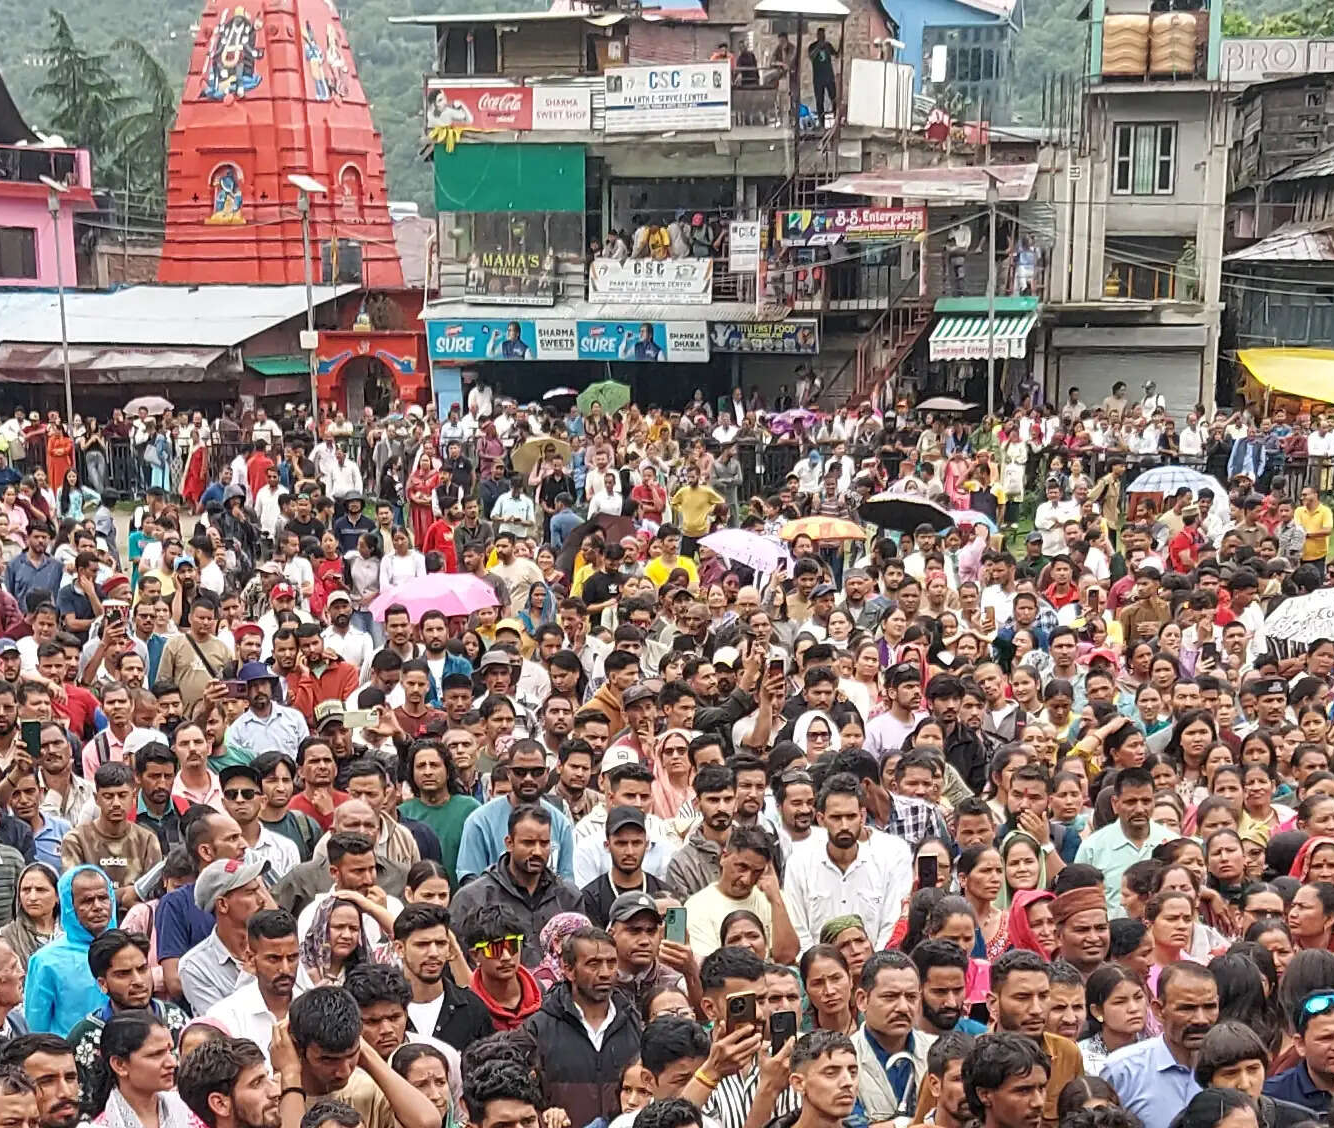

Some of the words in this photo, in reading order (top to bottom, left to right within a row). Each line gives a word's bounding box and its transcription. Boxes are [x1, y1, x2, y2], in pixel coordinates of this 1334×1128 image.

[649, 70, 681, 89] CSC
[546, 98, 578, 106] SHARMA
[684, 93, 708, 101] CENTER
[536, 111, 563, 119] SWEET
[566, 111, 587, 119] SHOP
[482, 253, 540, 268] MAMA'S
[633, 262, 665, 276] CSC
[538, 328, 575, 338] SHARMA
[774, 323, 797, 334] FOOD
[669, 332, 705, 340] SHANKAR
[435, 336, 475, 353] SURE
[539, 339, 575, 348] SWEETS
[580, 336, 617, 353] SURE
[674, 340, 701, 348] DHABA
